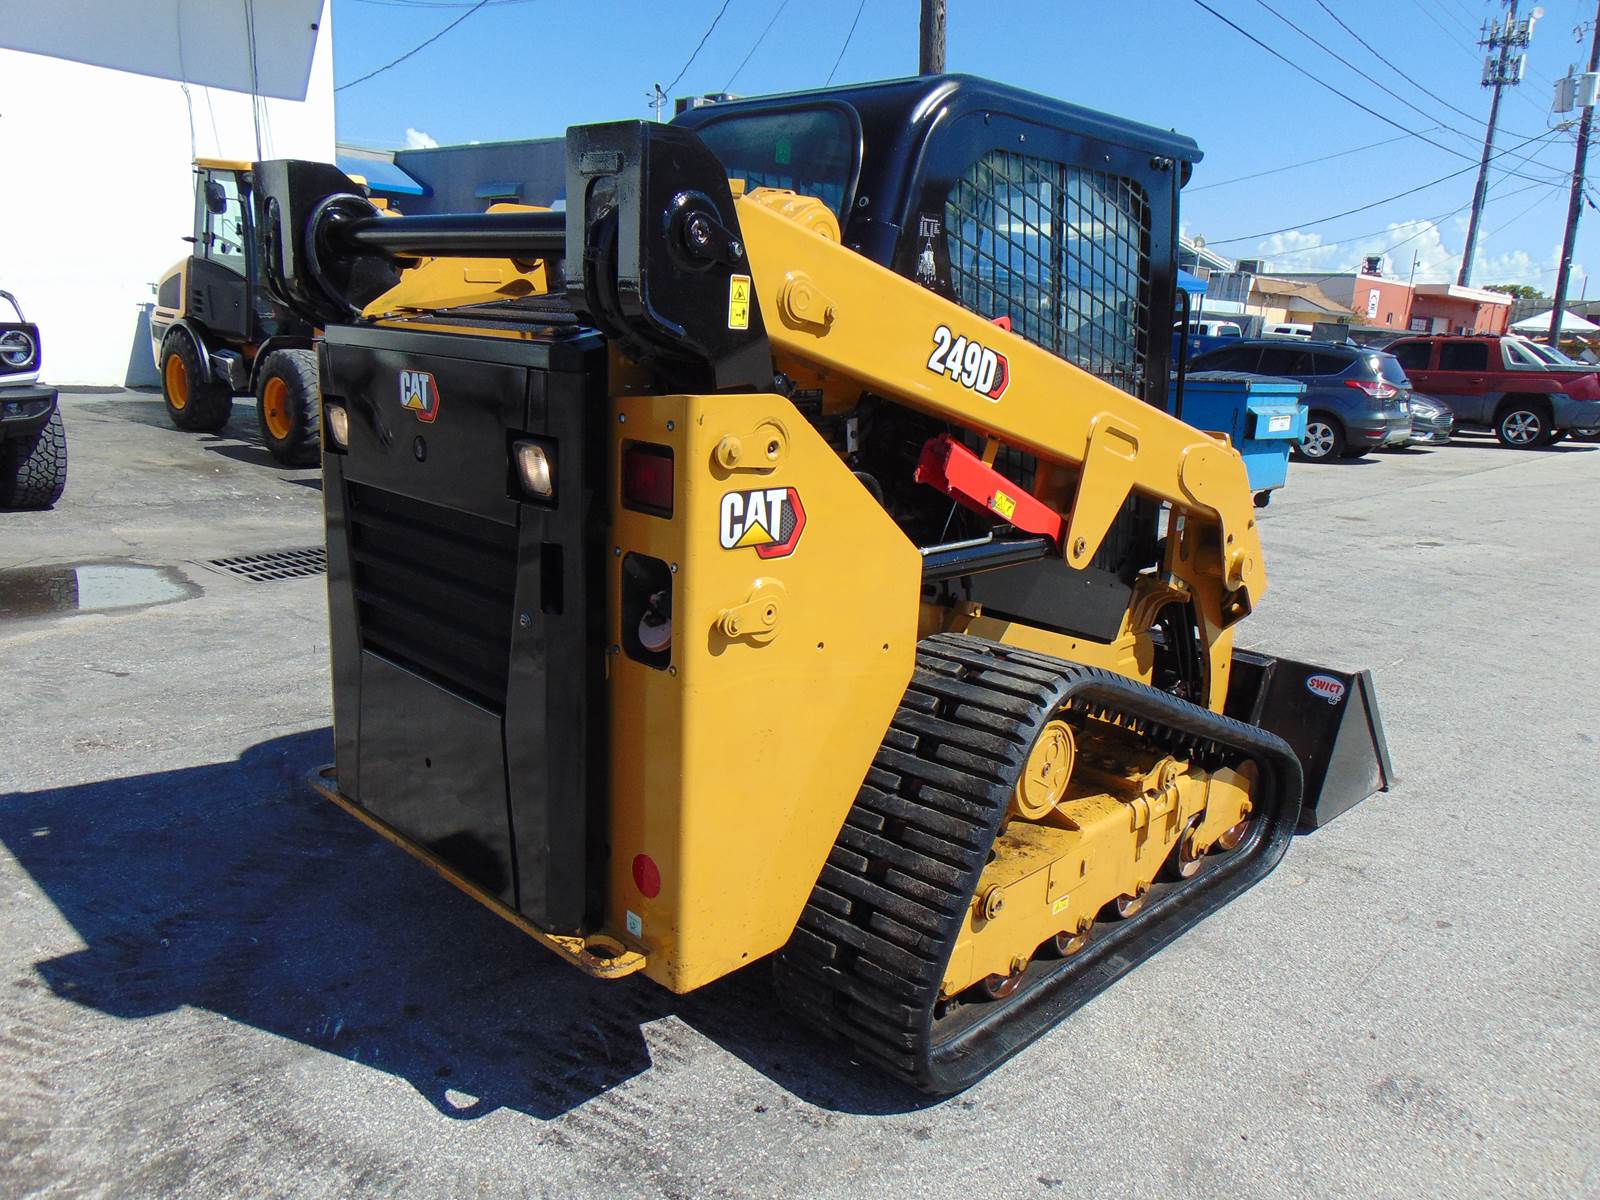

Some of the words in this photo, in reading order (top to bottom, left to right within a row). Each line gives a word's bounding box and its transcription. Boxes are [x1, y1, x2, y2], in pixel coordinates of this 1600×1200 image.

[927, 325, 998, 395] 249D
[400, 371, 429, 410] CAT
[720, 488, 788, 549] CAT
[1308, 678, 1341, 694] SWICT
